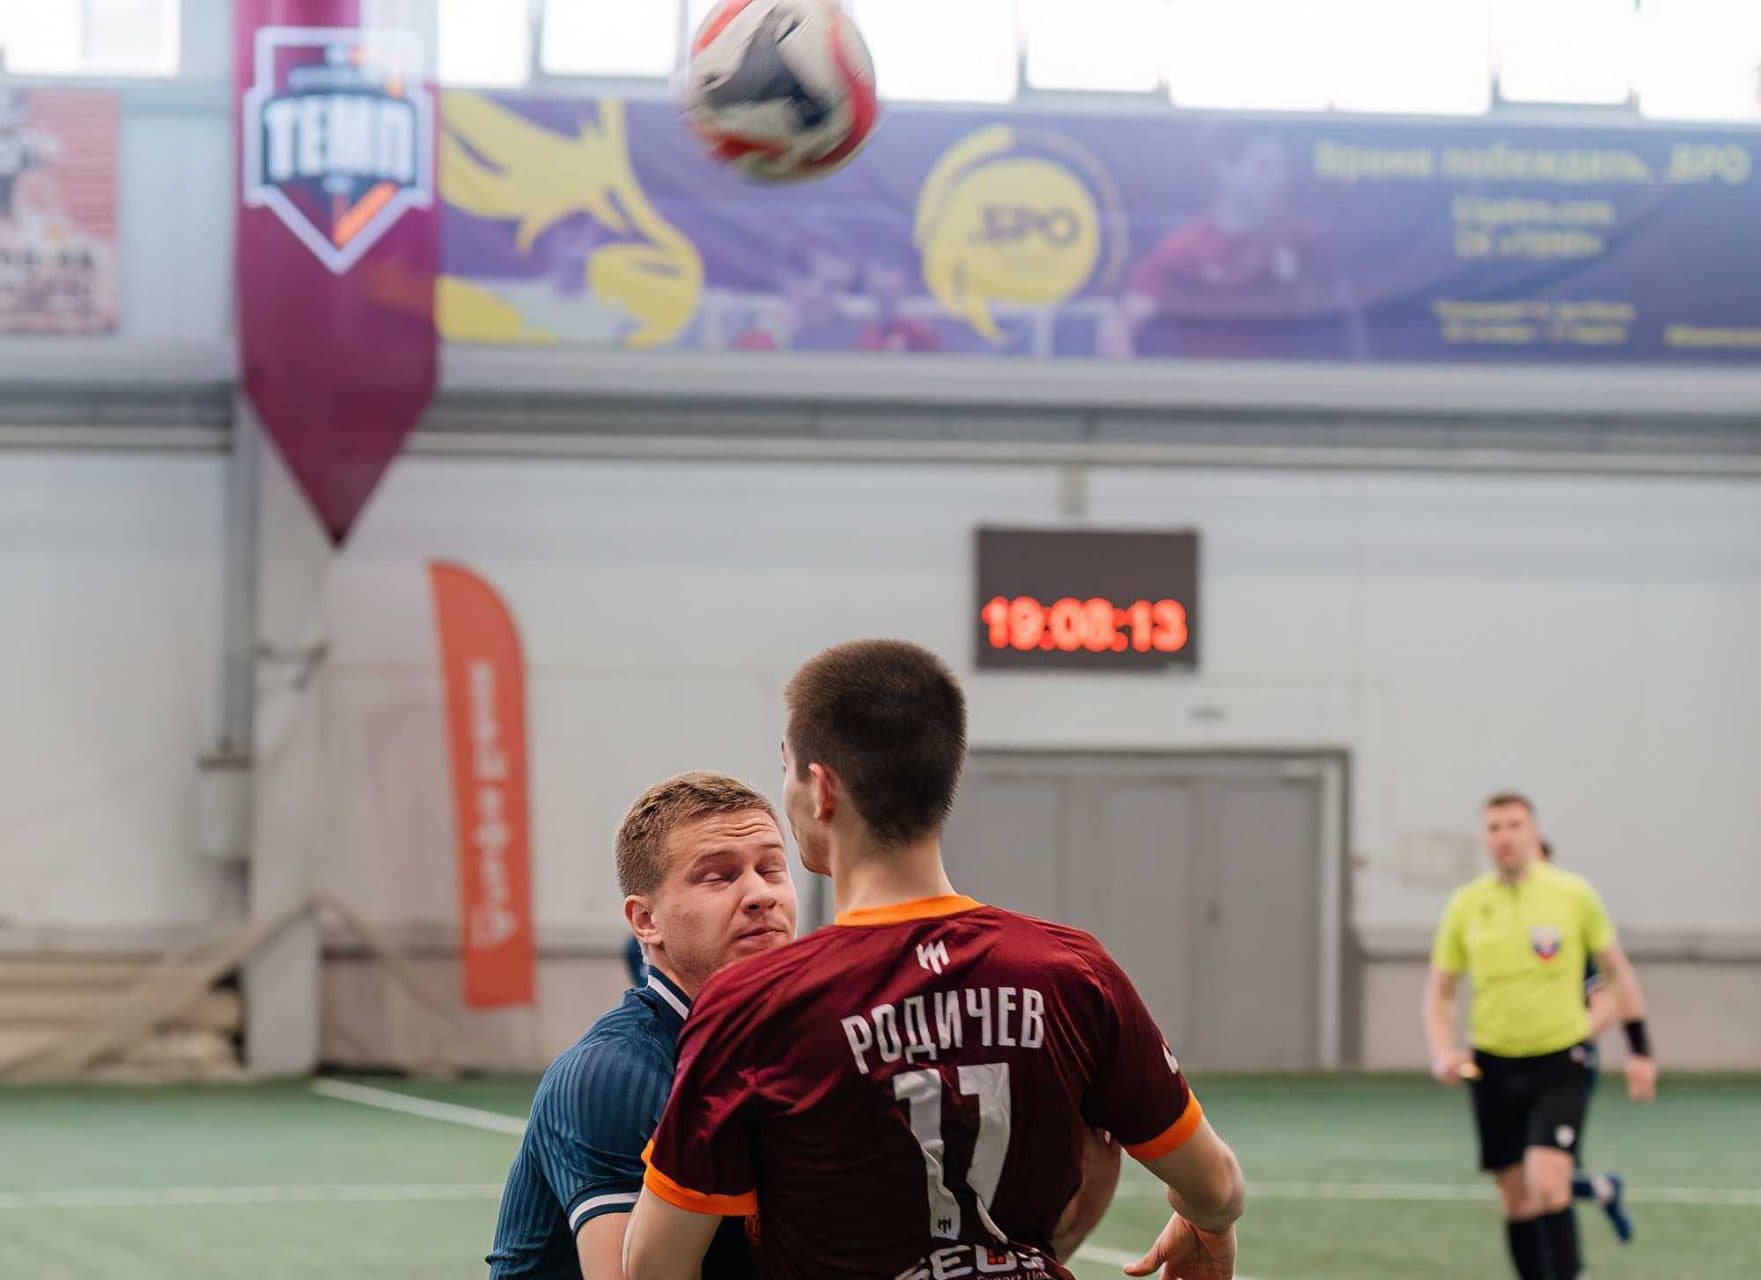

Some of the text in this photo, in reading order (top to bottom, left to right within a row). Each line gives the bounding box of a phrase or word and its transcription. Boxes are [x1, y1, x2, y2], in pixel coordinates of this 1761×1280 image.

[263, 93, 412, 182] ТЕМП
[840, 987, 1045, 1075] РОДИЧЕВ
[893, 1062, 1011, 1244] 17
